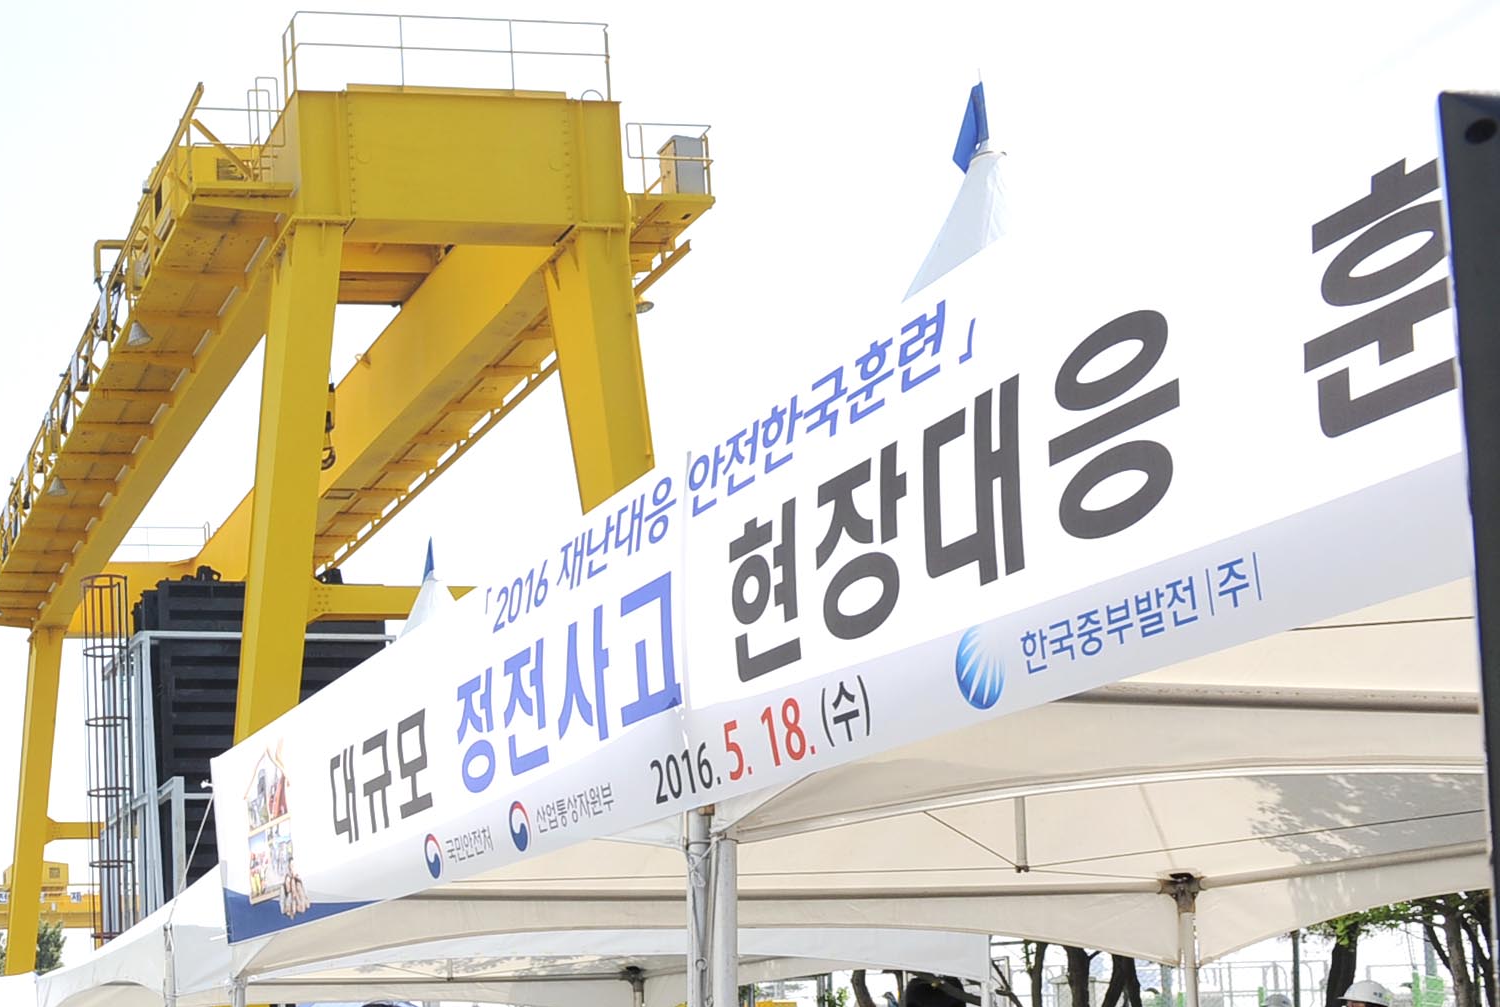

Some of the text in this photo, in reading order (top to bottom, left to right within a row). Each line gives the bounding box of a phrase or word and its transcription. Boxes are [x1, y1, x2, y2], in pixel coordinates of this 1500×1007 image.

[329, 707, 434, 845] 대규모
[456, 570, 683, 794] 정전사고
[727, 309, 1181, 683] 현장대응
[556, 475, 678, 592] 재난대응
[649, 674, 872, 805] 2016. 5. 18. (수)
[444, 782, 616, 864] 국민안전처 산업통상자원부
